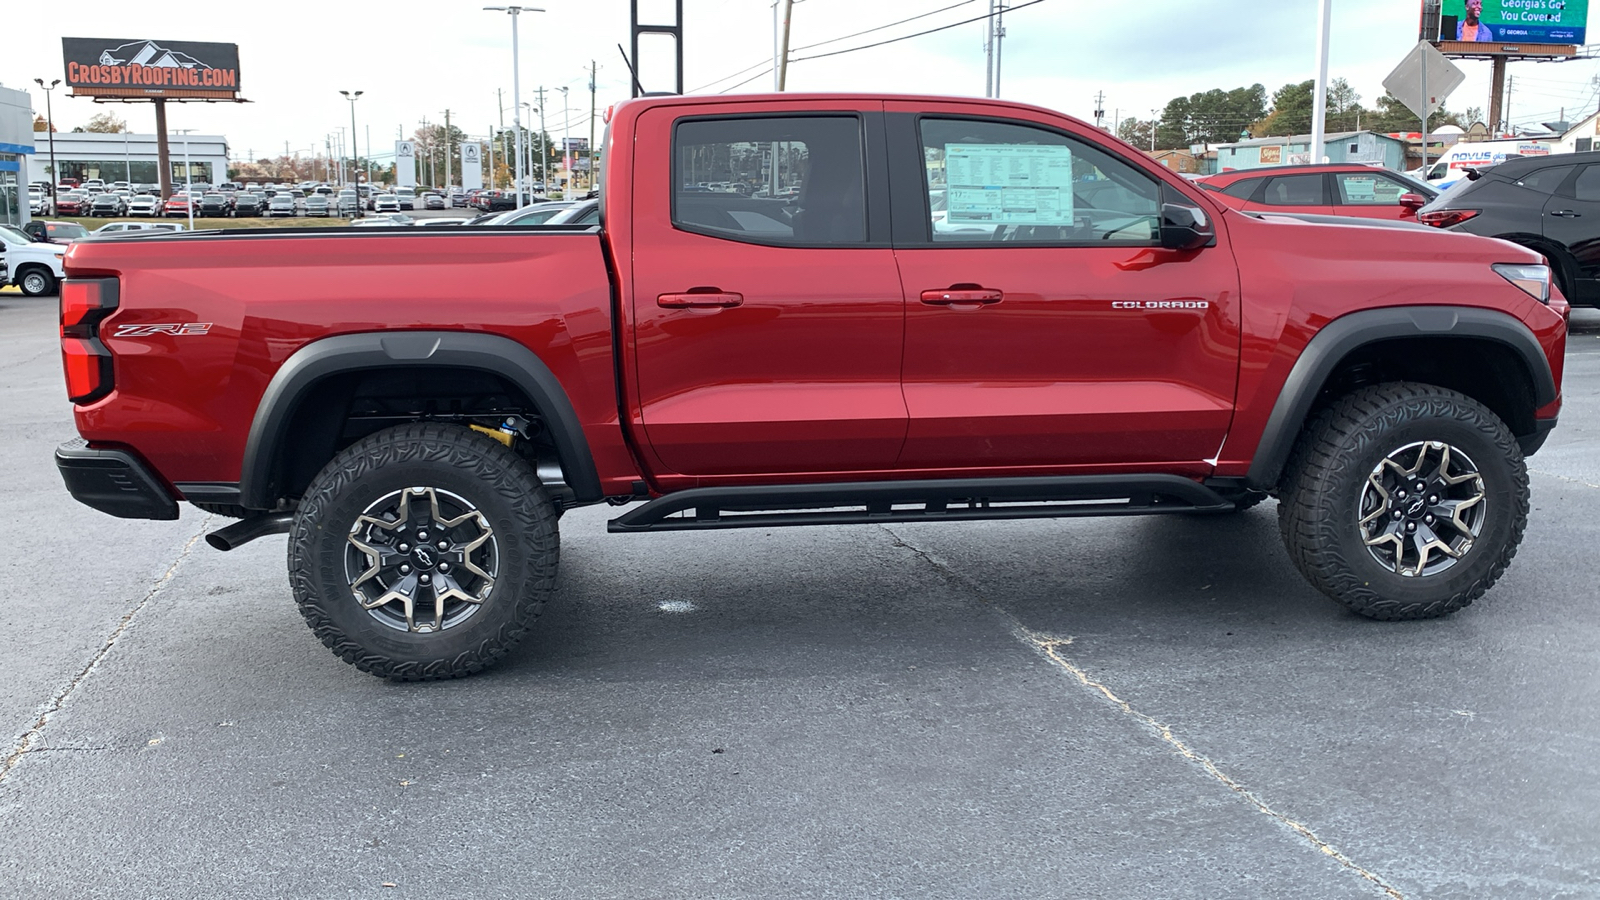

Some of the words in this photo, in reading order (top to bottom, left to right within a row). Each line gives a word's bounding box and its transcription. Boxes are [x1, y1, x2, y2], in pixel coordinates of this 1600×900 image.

[1501, 0, 1546, 10] Georgia's
[1501, 10, 1518, 20] You
[1521, 11, 1561, 22] Covered
[1111, 301, 1209, 309] COLORADO
[113, 322, 213, 337] ZR2
